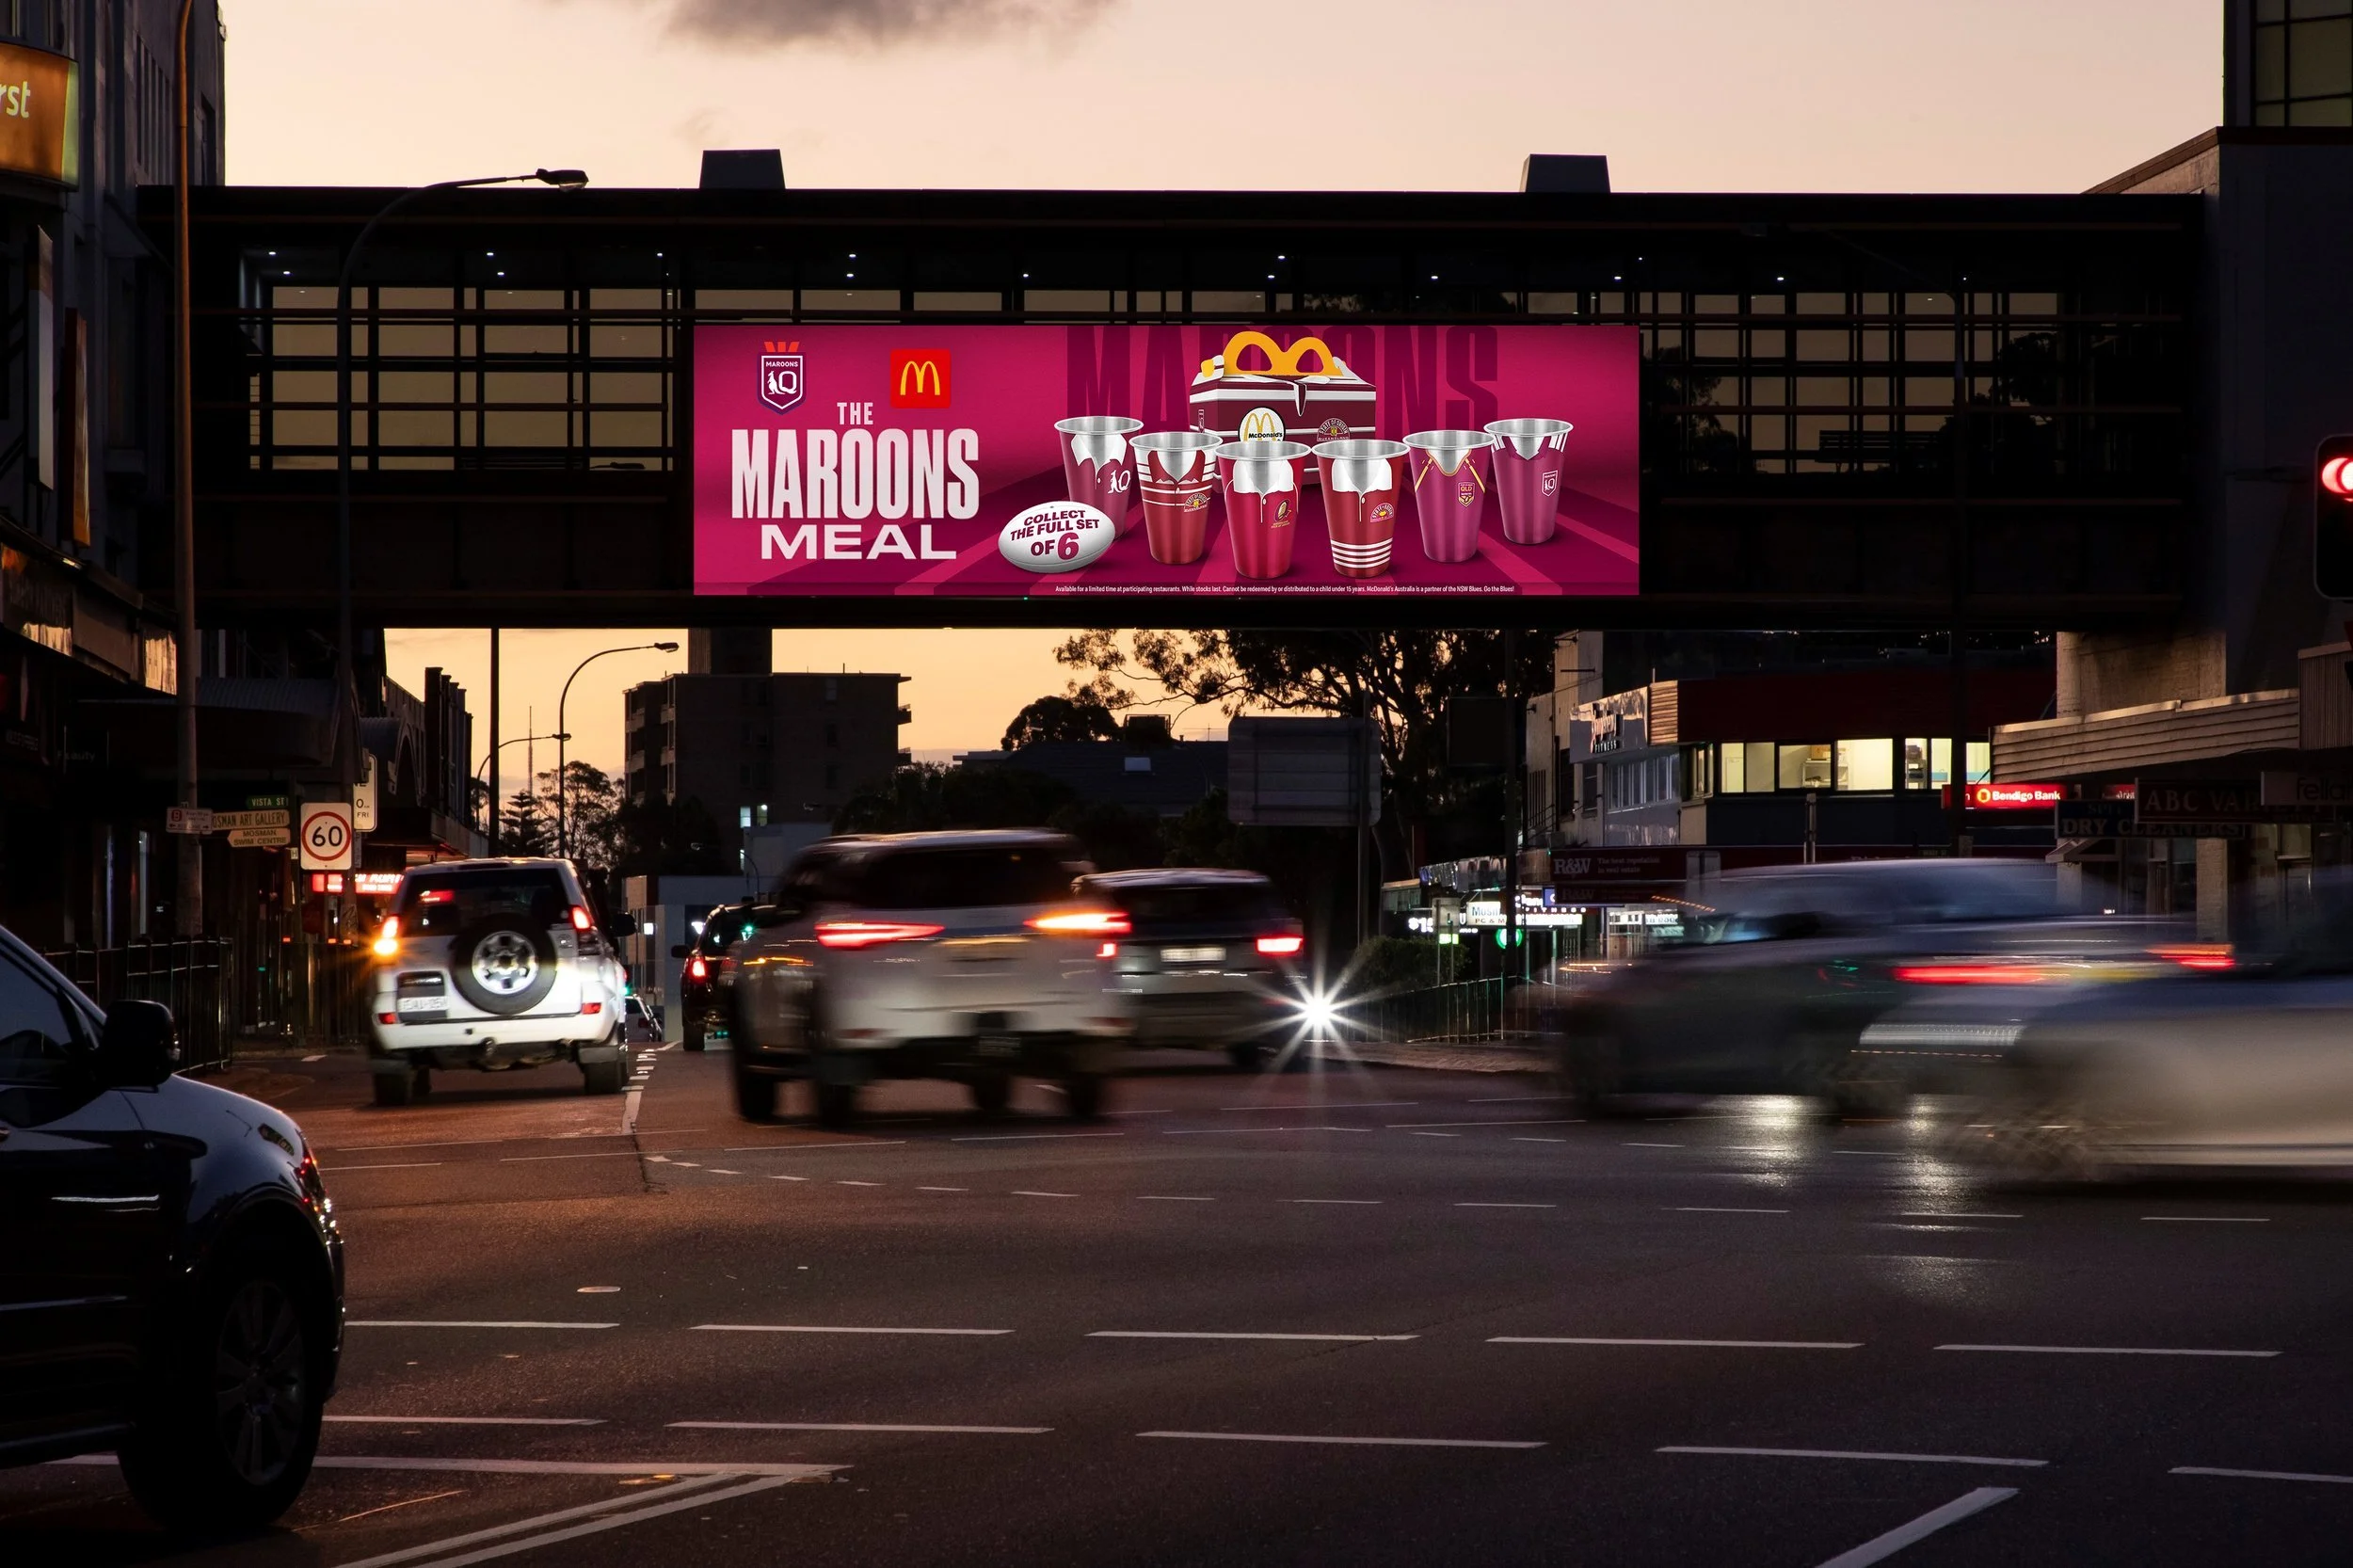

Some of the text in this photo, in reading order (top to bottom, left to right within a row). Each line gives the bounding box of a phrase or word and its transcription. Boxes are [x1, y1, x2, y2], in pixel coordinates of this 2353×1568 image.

[837, 402, 873, 424] THE
[732, 428, 979, 519] MAROONS
[1024, 510, 1085, 526] COLLECT
[1010, 520, 1099, 541] THE FULL SET
[760, 524, 956, 559] MEAL
[1031, 532, 1080, 560] OF 6
[1123, 585, 1152, 594] participating
[1272, 585, 1277, 594] by
[1353, 585, 1366, 594] years.
[1424, 585, 1441, 594] partner
[251, 797, 285, 806] VISTA ST
[1992, 791, 2061, 803] Bendigo Bank
[2144, 790, 2201, 812] ABC
[213, 814, 236, 828] OSMAN
[239, 812, 252, 826] ART
[255, 811, 286, 825] GALLERY
[2062, 818, 2108, 836] DRY
[233, 837, 287, 846] SWIM CENTRE
[312, 825, 343, 846] 60
[1553, 857, 1592, 874] R&W
